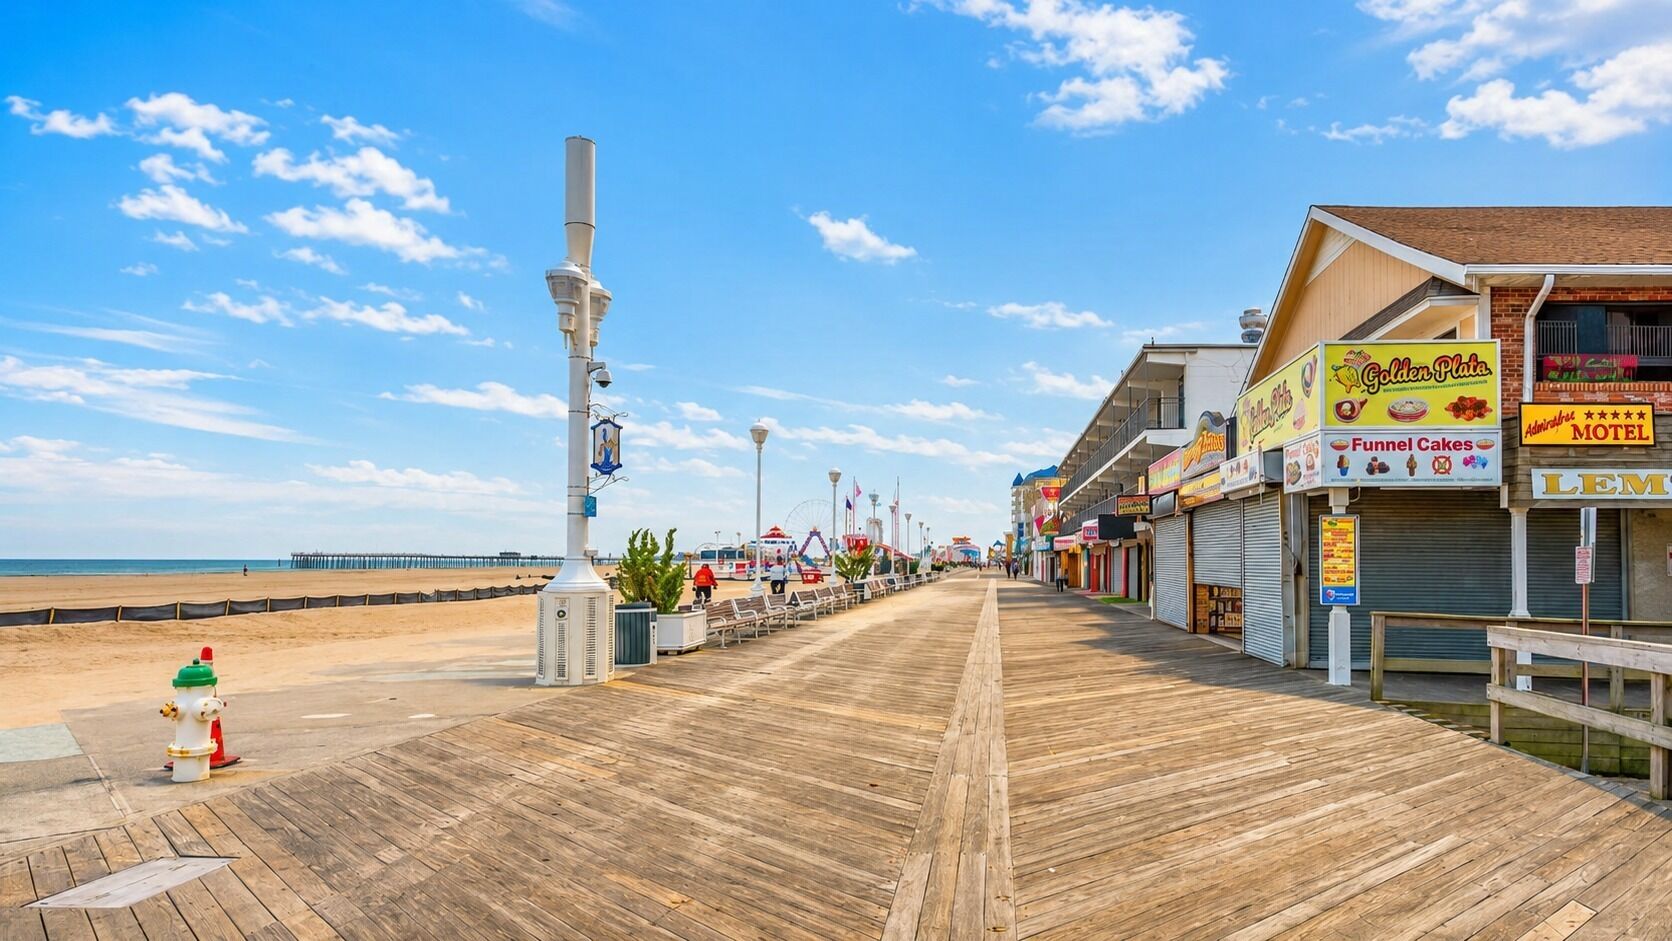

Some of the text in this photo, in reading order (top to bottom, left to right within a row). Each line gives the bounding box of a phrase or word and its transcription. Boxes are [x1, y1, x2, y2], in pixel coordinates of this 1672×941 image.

[1361, 357, 1432, 395] Golden
[1570, 423, 1650, 441] MOTEL
[1351, 437, 1474, 452] Funnel Cakes
[1540, 473, 1672, 496] LEM
